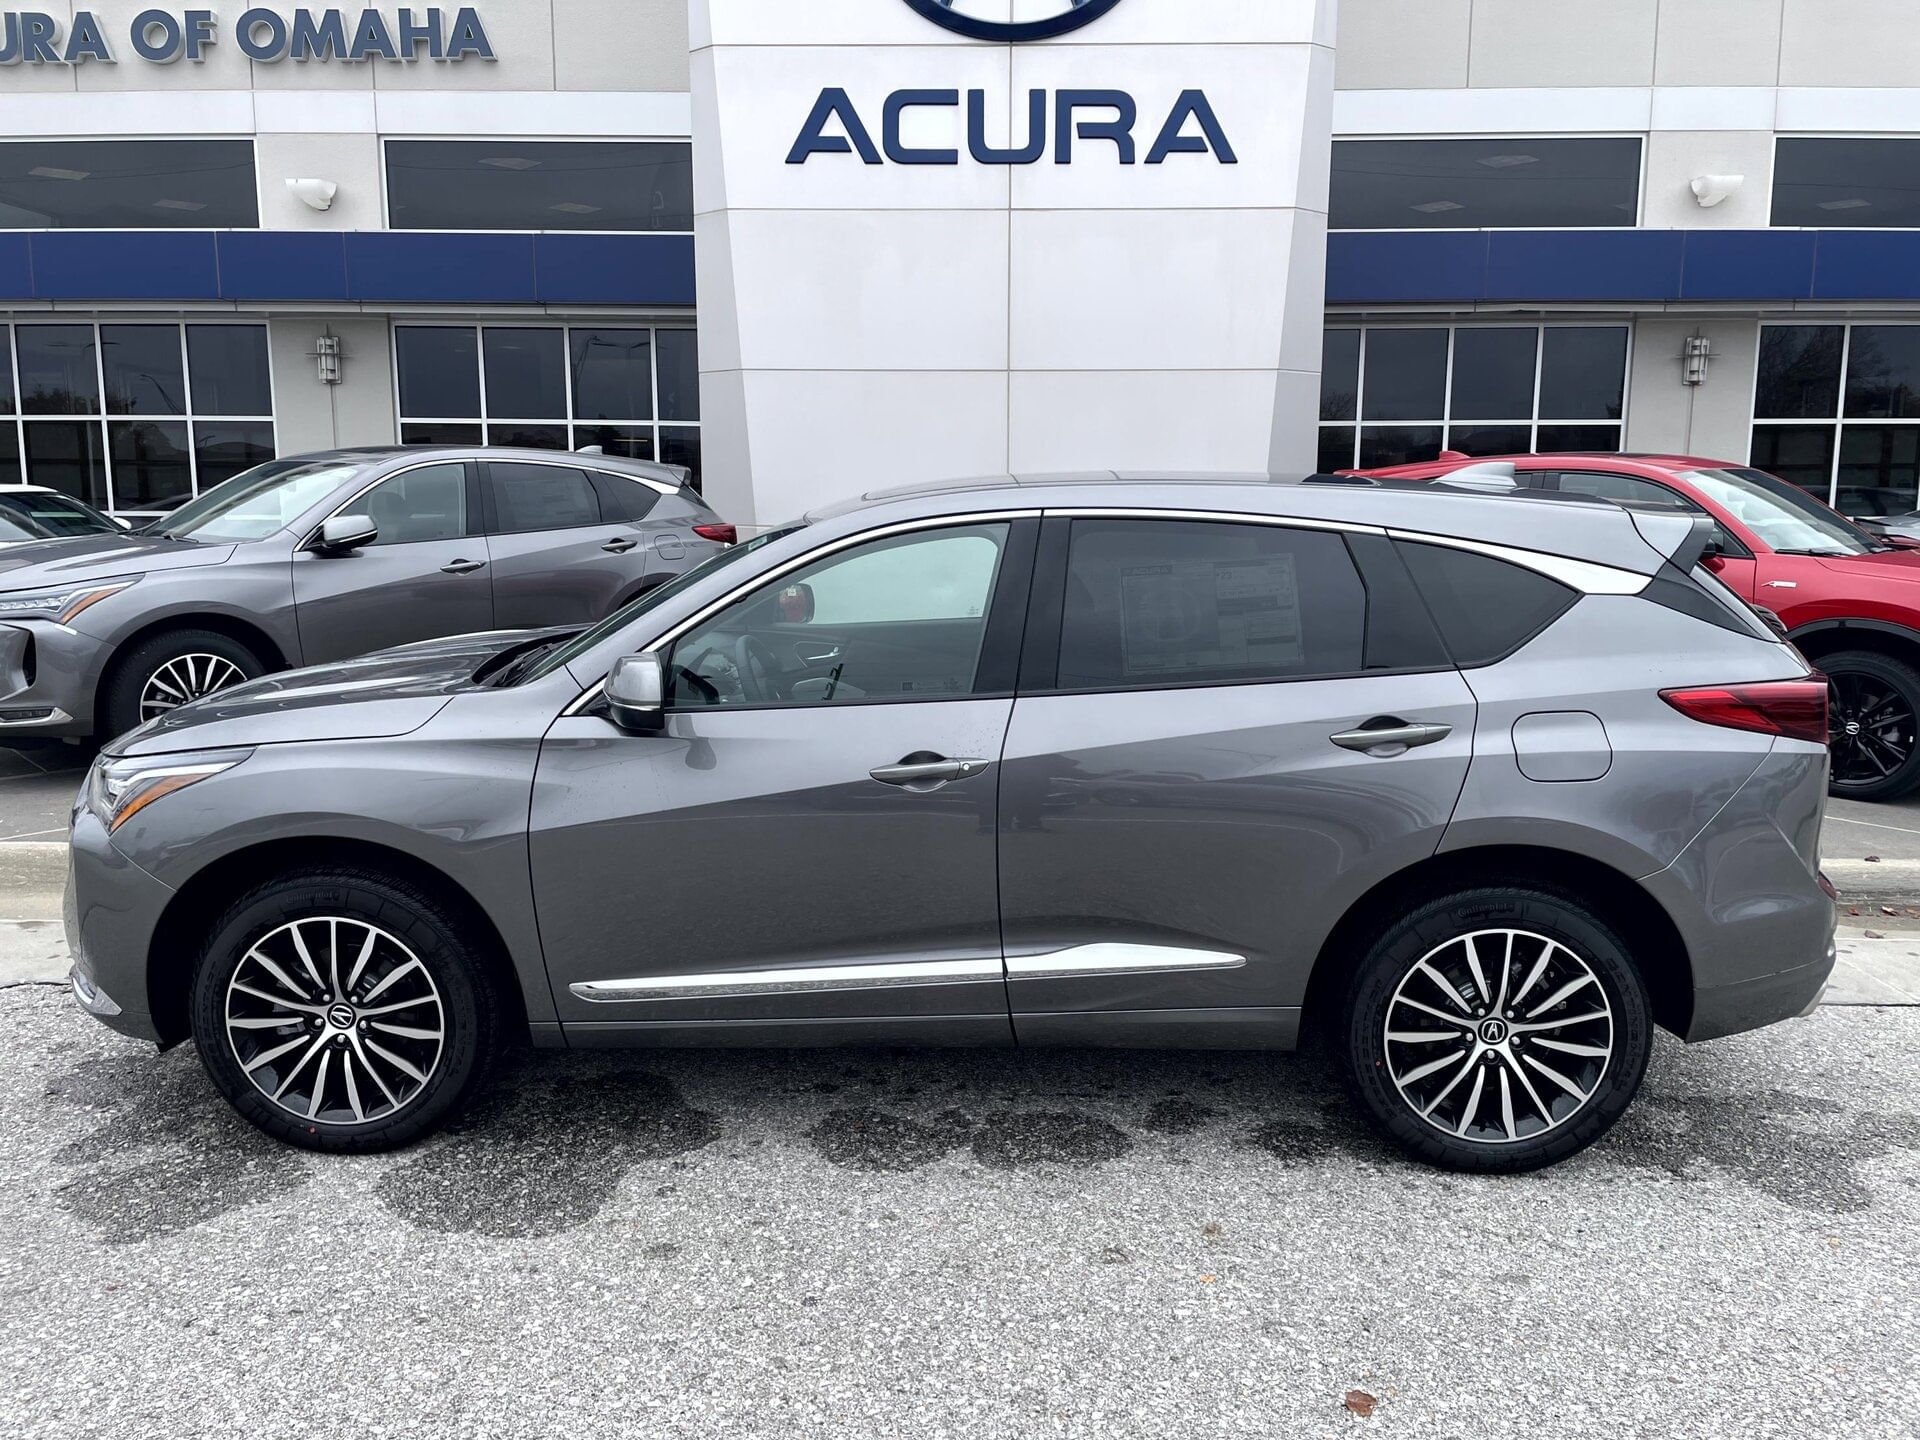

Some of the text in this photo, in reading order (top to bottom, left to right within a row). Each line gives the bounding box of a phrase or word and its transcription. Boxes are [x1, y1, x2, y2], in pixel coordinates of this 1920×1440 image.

[130, 9, 216, 63] OF
[235, 7, 496, 62] OMAHA
[785, 87, 1238, 164] ACURA
